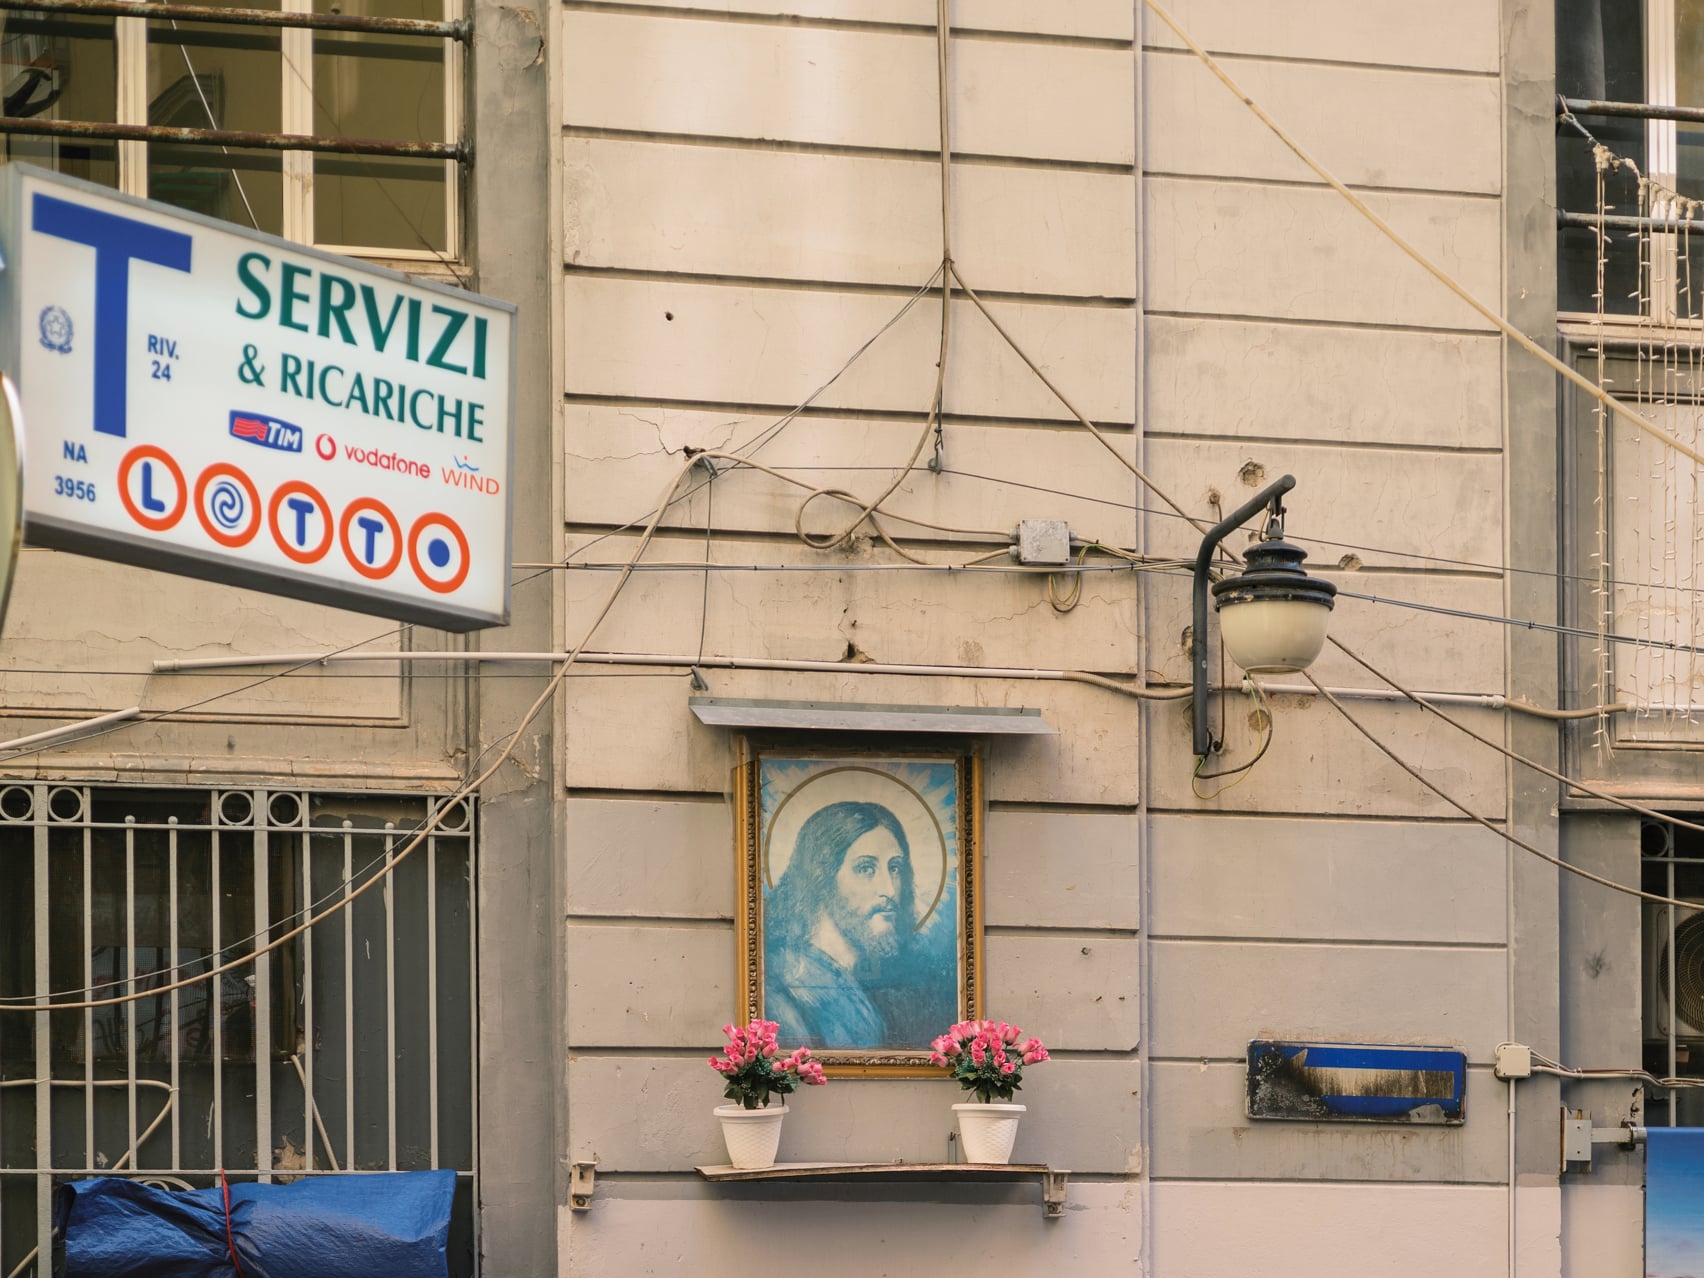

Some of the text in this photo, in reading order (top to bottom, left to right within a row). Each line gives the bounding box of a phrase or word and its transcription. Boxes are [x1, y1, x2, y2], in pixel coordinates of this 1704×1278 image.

[32, 191, 193, 439] T
[235, 251, 489, 380] SERVIZI
[147, 333, 180, 361] RIV.
[151, 360, 172, 383] 24
[237, 343, 485, 443] & RICARICHE
[266, 421, 301, 450] TIM
[63, 440, 88, 464] NA
[344, 444, 431, 479] vodafone
[54, 475, 97, 503] 3956
[441, 466, 500, 496] WIND
